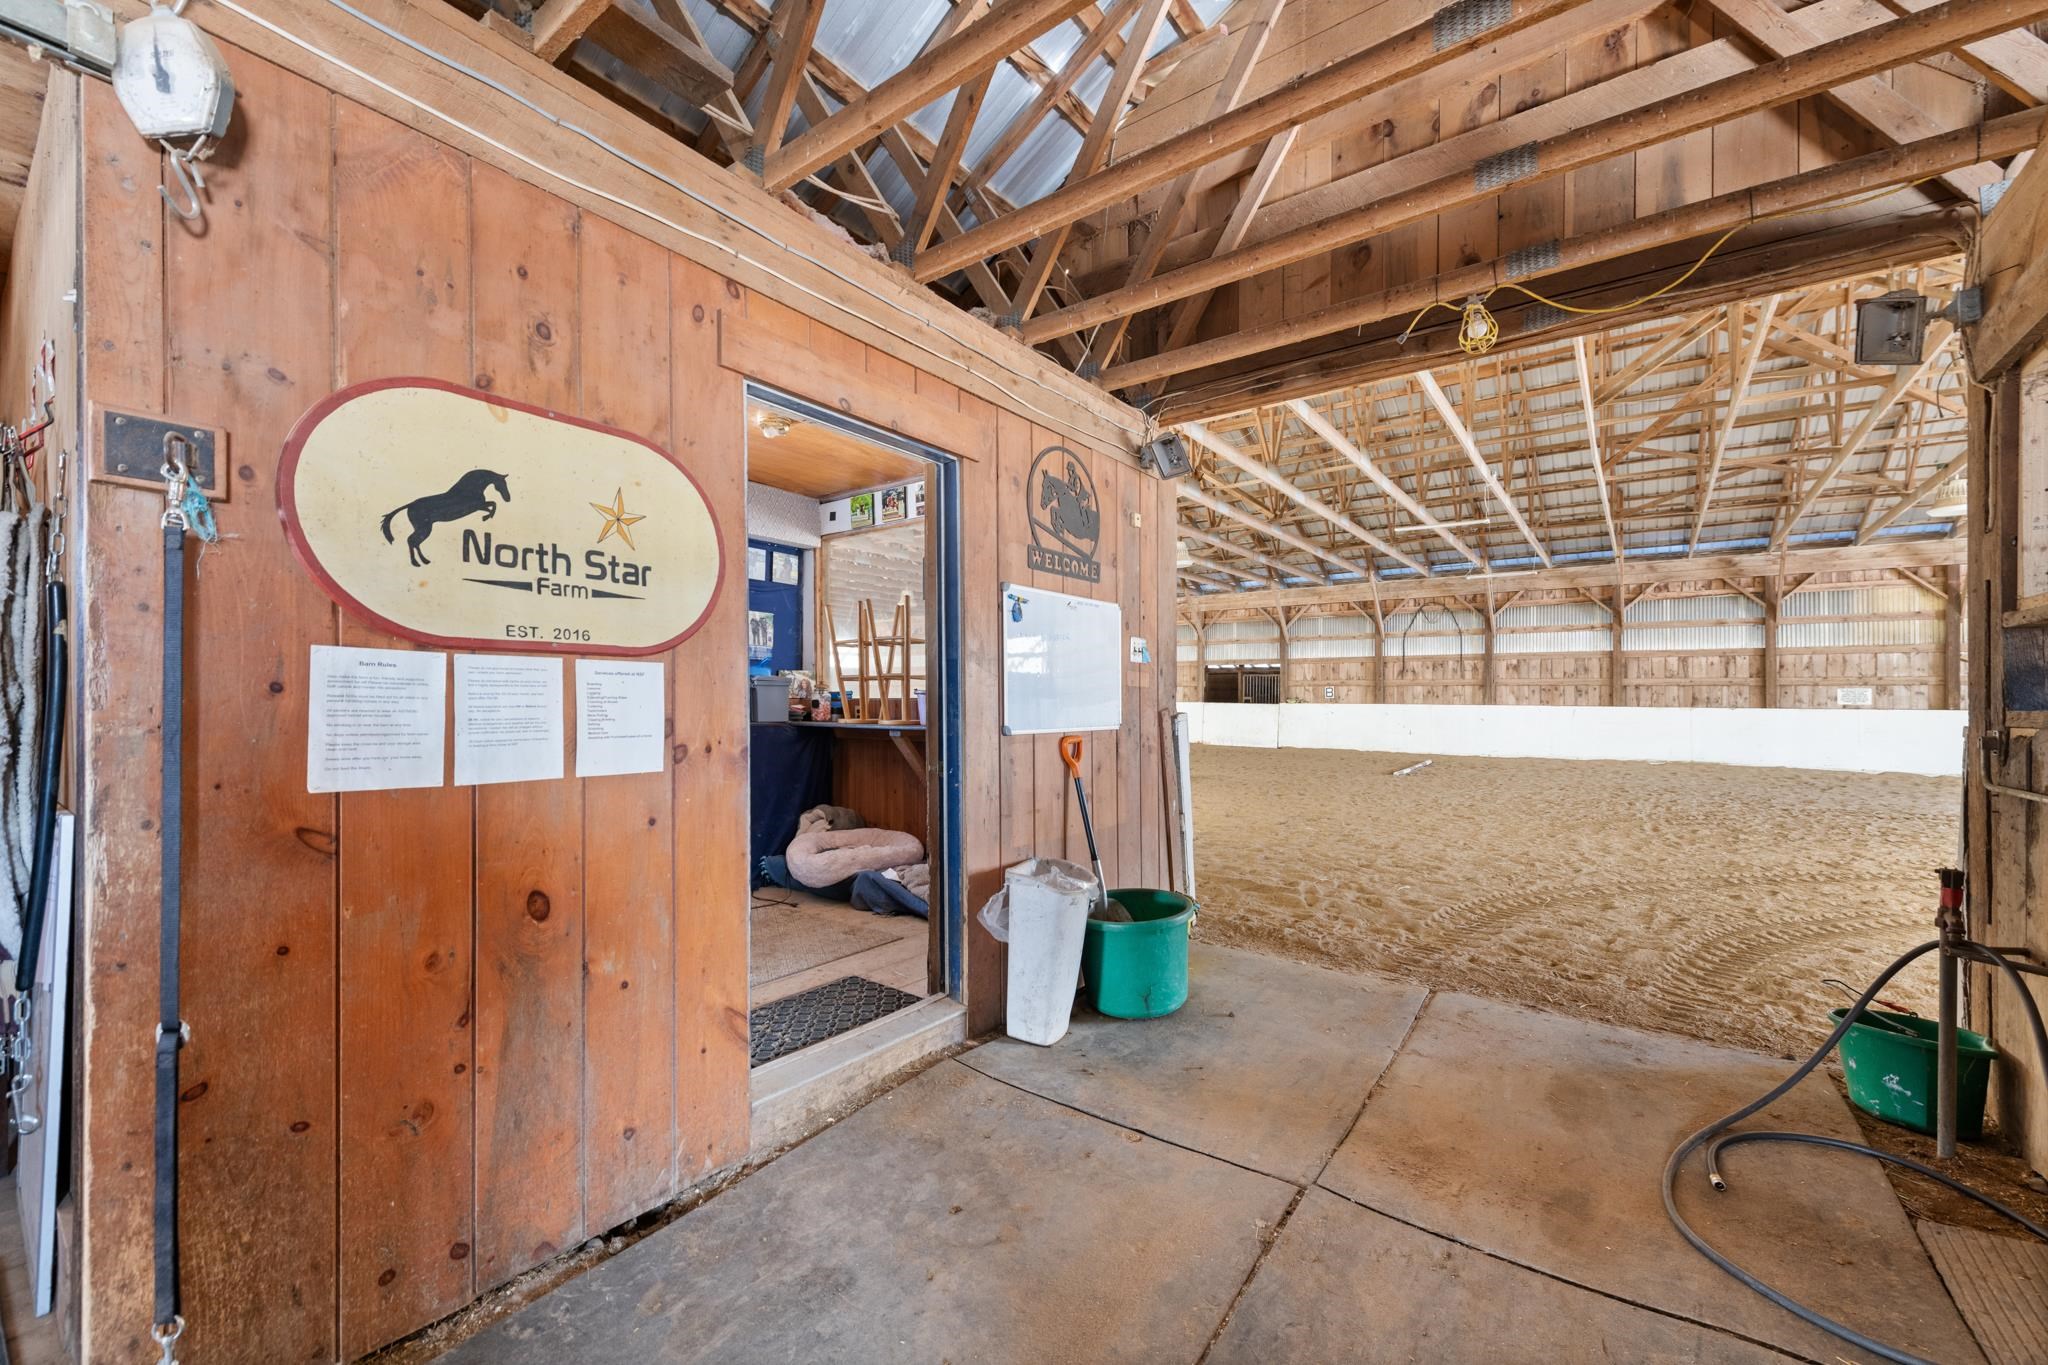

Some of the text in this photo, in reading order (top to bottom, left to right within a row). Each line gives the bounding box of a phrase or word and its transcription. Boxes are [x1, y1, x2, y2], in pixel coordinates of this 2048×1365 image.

[463, 529, 651, 586] North Star
[1031, 549, 1098, 579] WELCOME
[536, 577, 588, 599] Farm
[505, 624, 591, 642] EST. 2016
[1325, 687, 1334, 698] B
